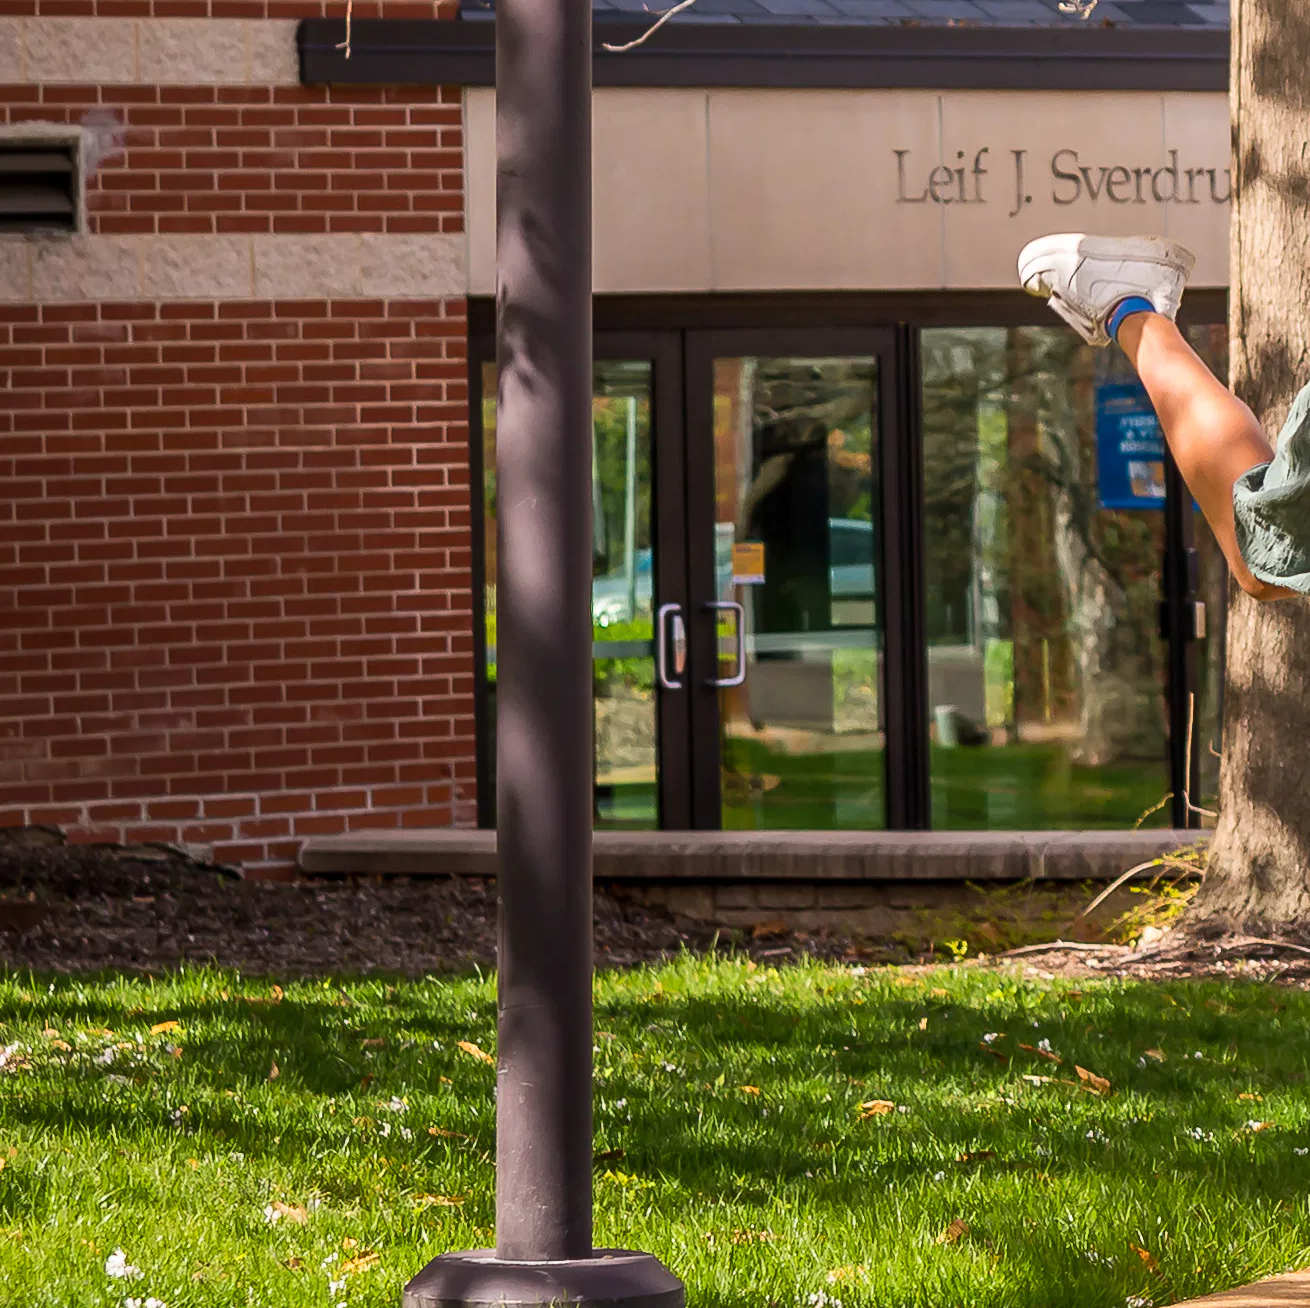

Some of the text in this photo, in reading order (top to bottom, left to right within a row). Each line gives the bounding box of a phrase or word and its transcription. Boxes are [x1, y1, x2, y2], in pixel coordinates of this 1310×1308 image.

[892, 147, 989, 205] Leif
[1009, 149, 1033, 218] J.
[1050, 148, 1232, 206] Sverdru
